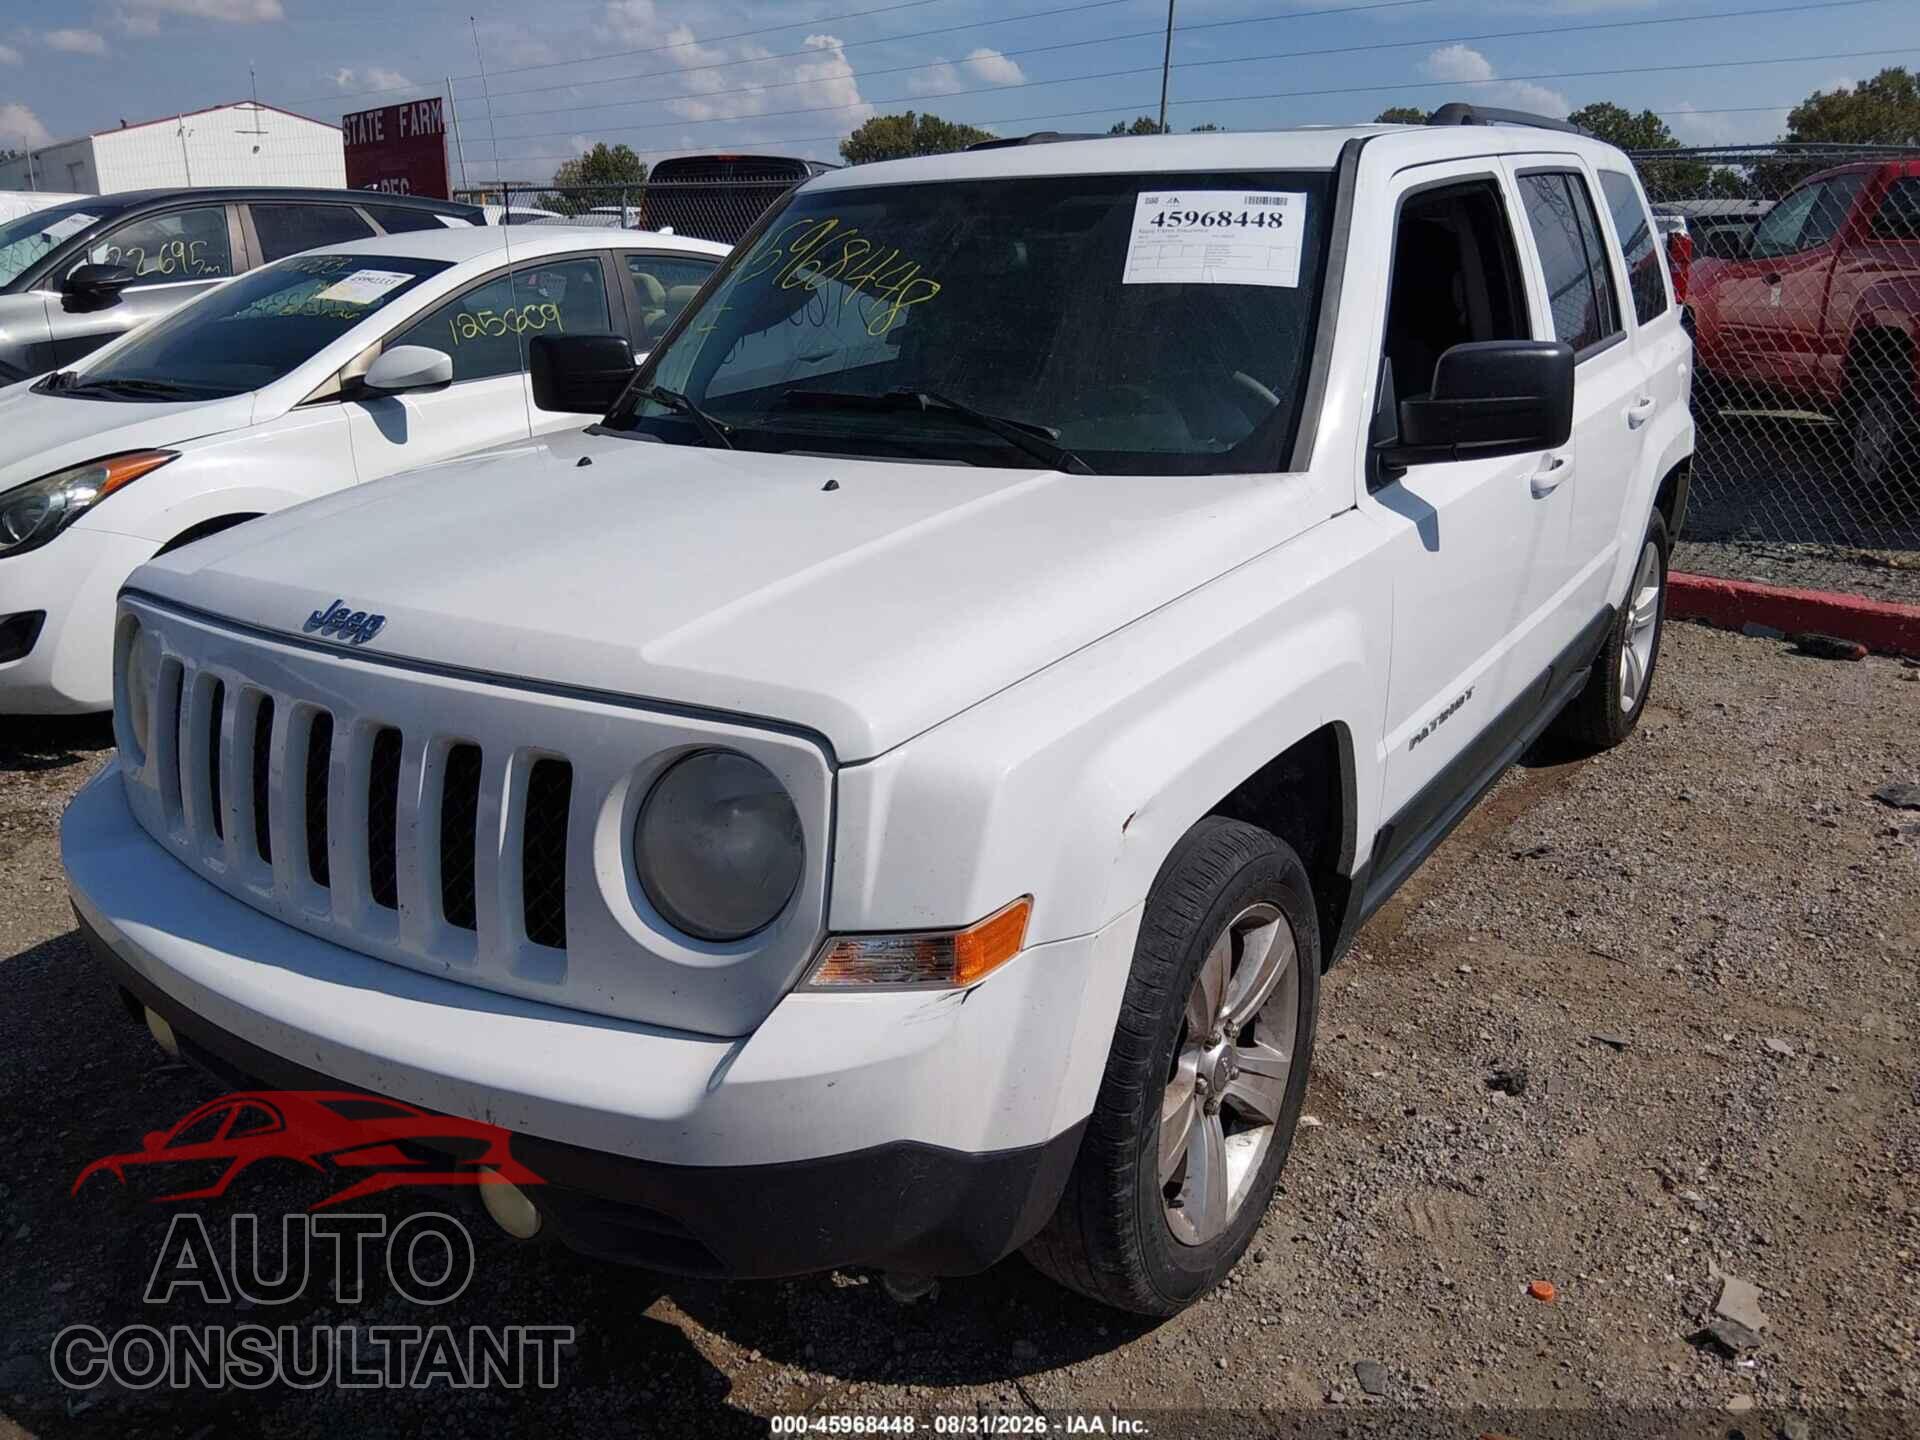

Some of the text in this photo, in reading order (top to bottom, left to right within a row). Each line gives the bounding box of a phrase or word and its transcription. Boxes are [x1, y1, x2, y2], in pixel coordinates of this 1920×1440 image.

[343, 100, 447, 146] STATE FARM
[1150, 211, 1284, 229] 45968448
[303, 599, 386, 645] Jeep
[1408, 686, 1475, 752] PATRIOT
